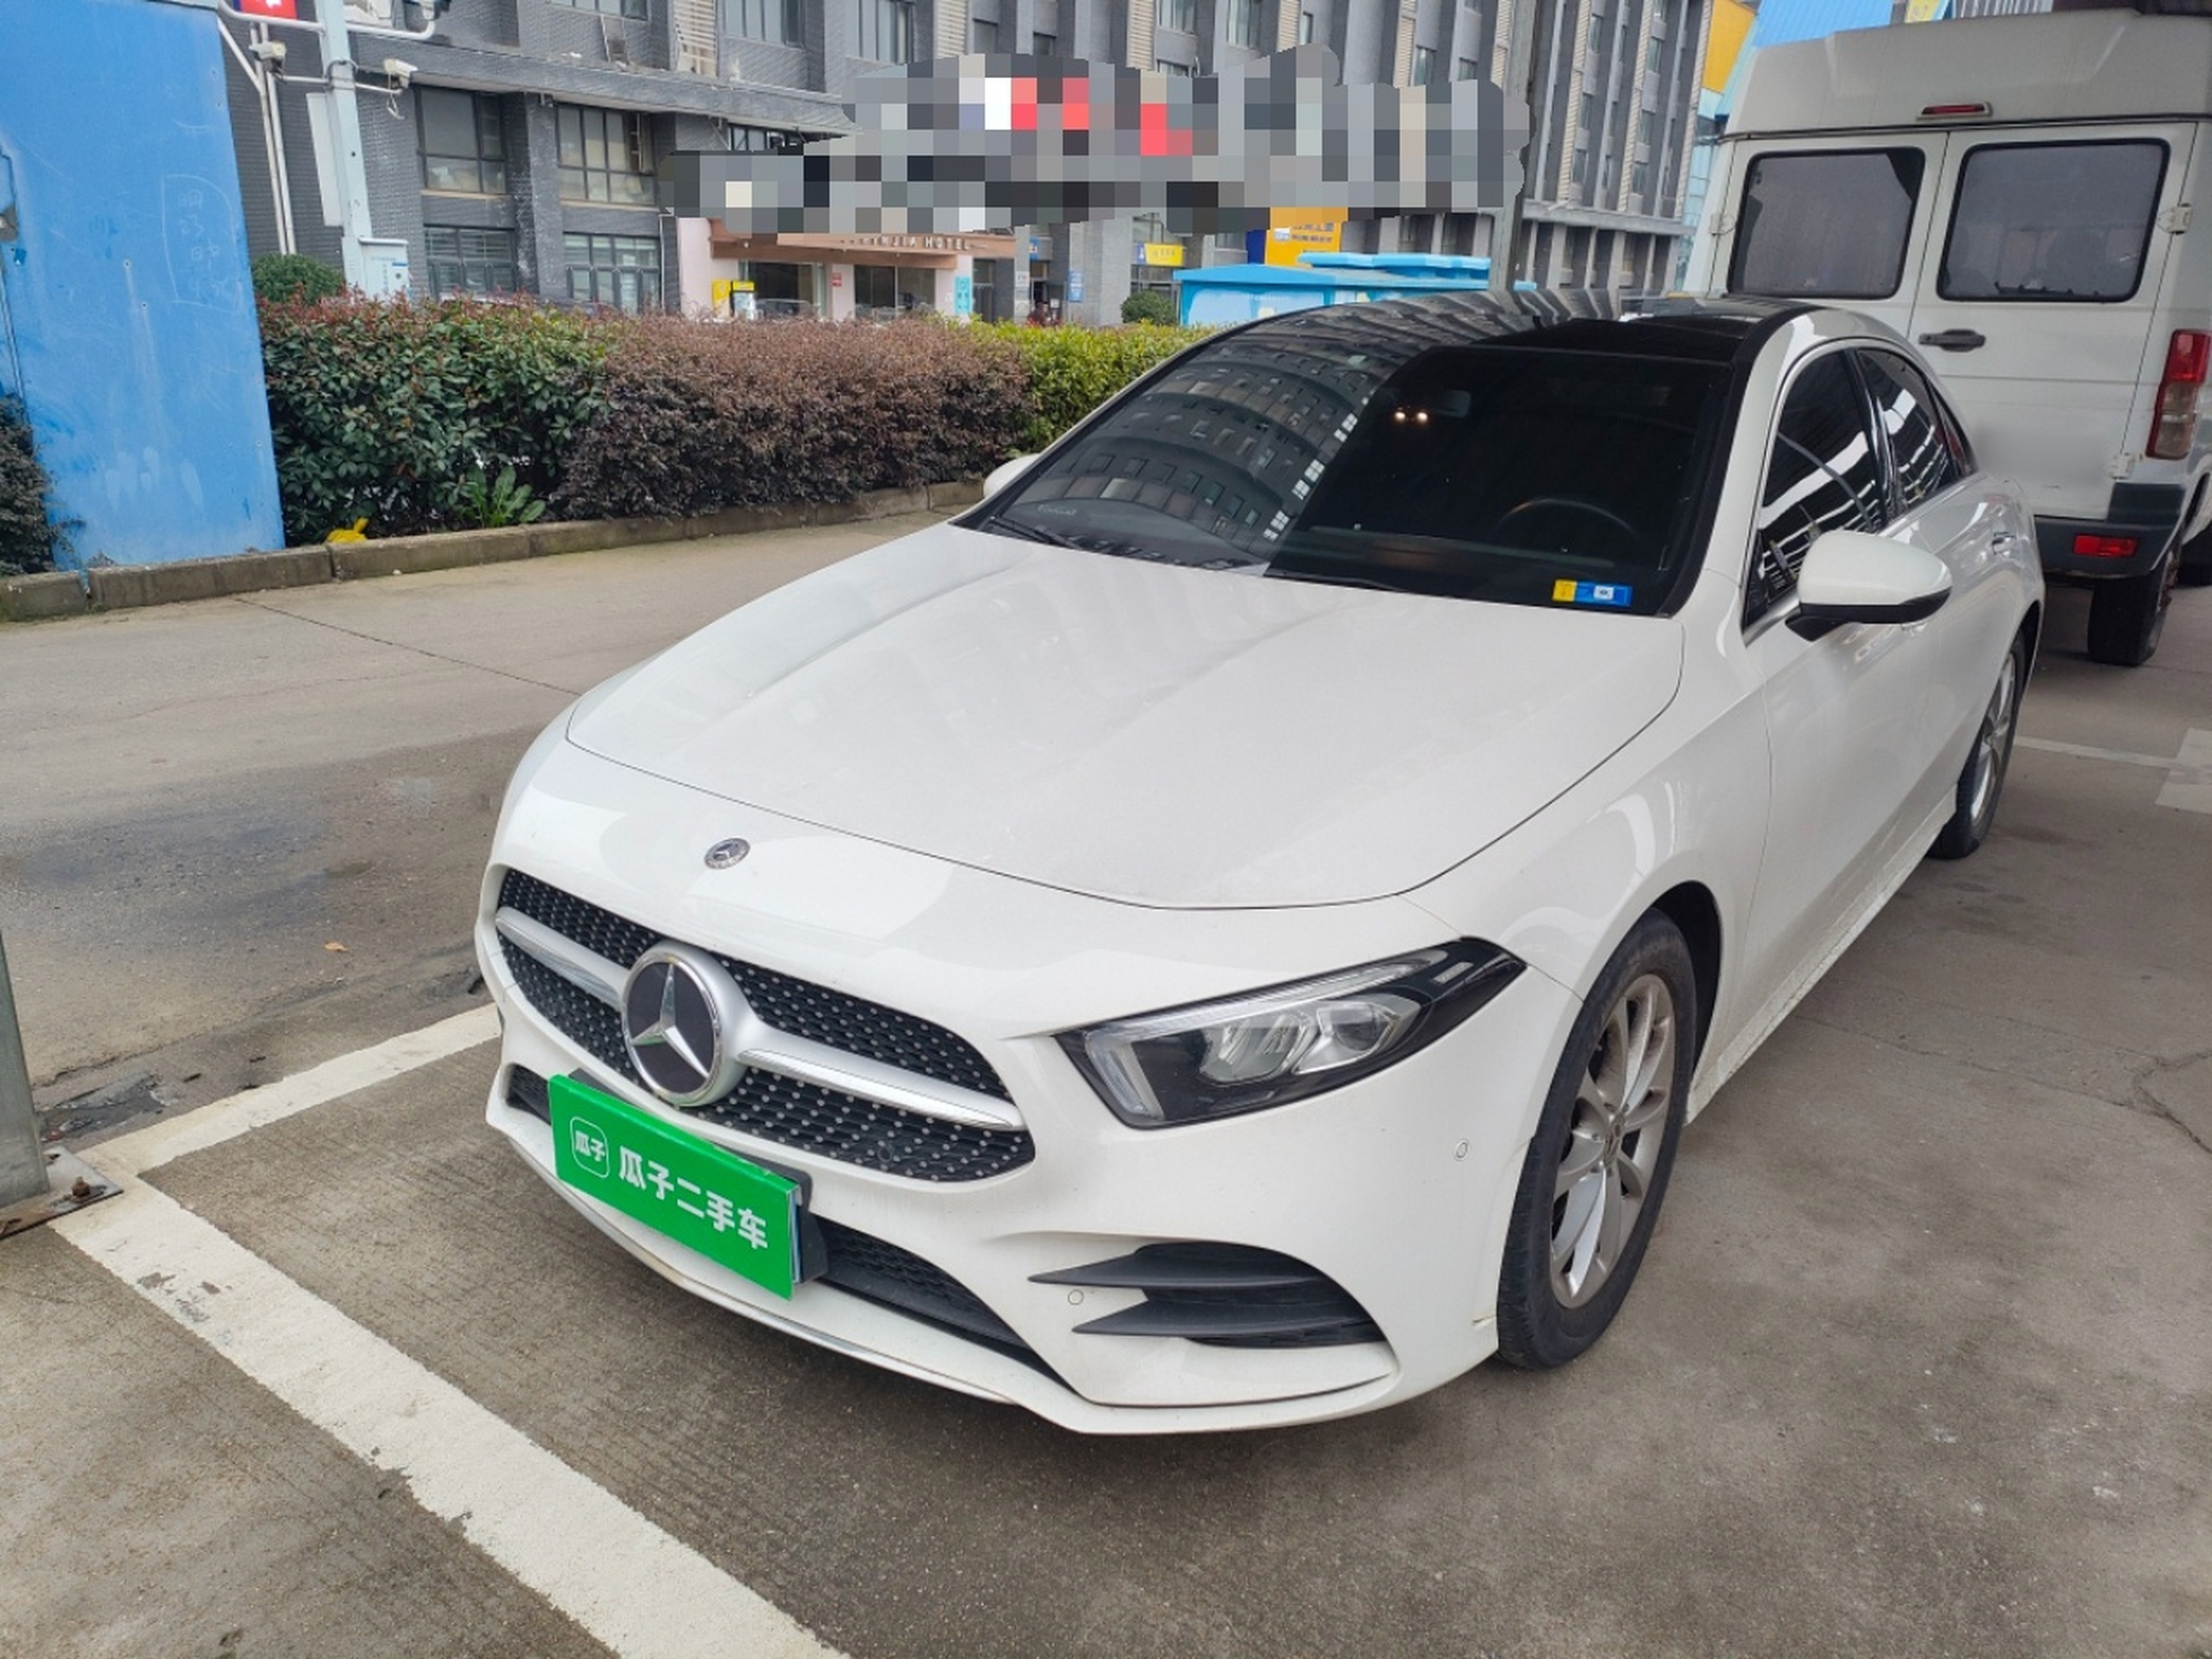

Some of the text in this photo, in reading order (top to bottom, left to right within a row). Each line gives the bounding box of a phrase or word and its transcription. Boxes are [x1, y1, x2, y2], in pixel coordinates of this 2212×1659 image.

[925, 236, 970, 251] HOTEL
[575, 1130, 606, 1162] 瓜子
[618, 1145, 768, 1250] 瓜子二手车
